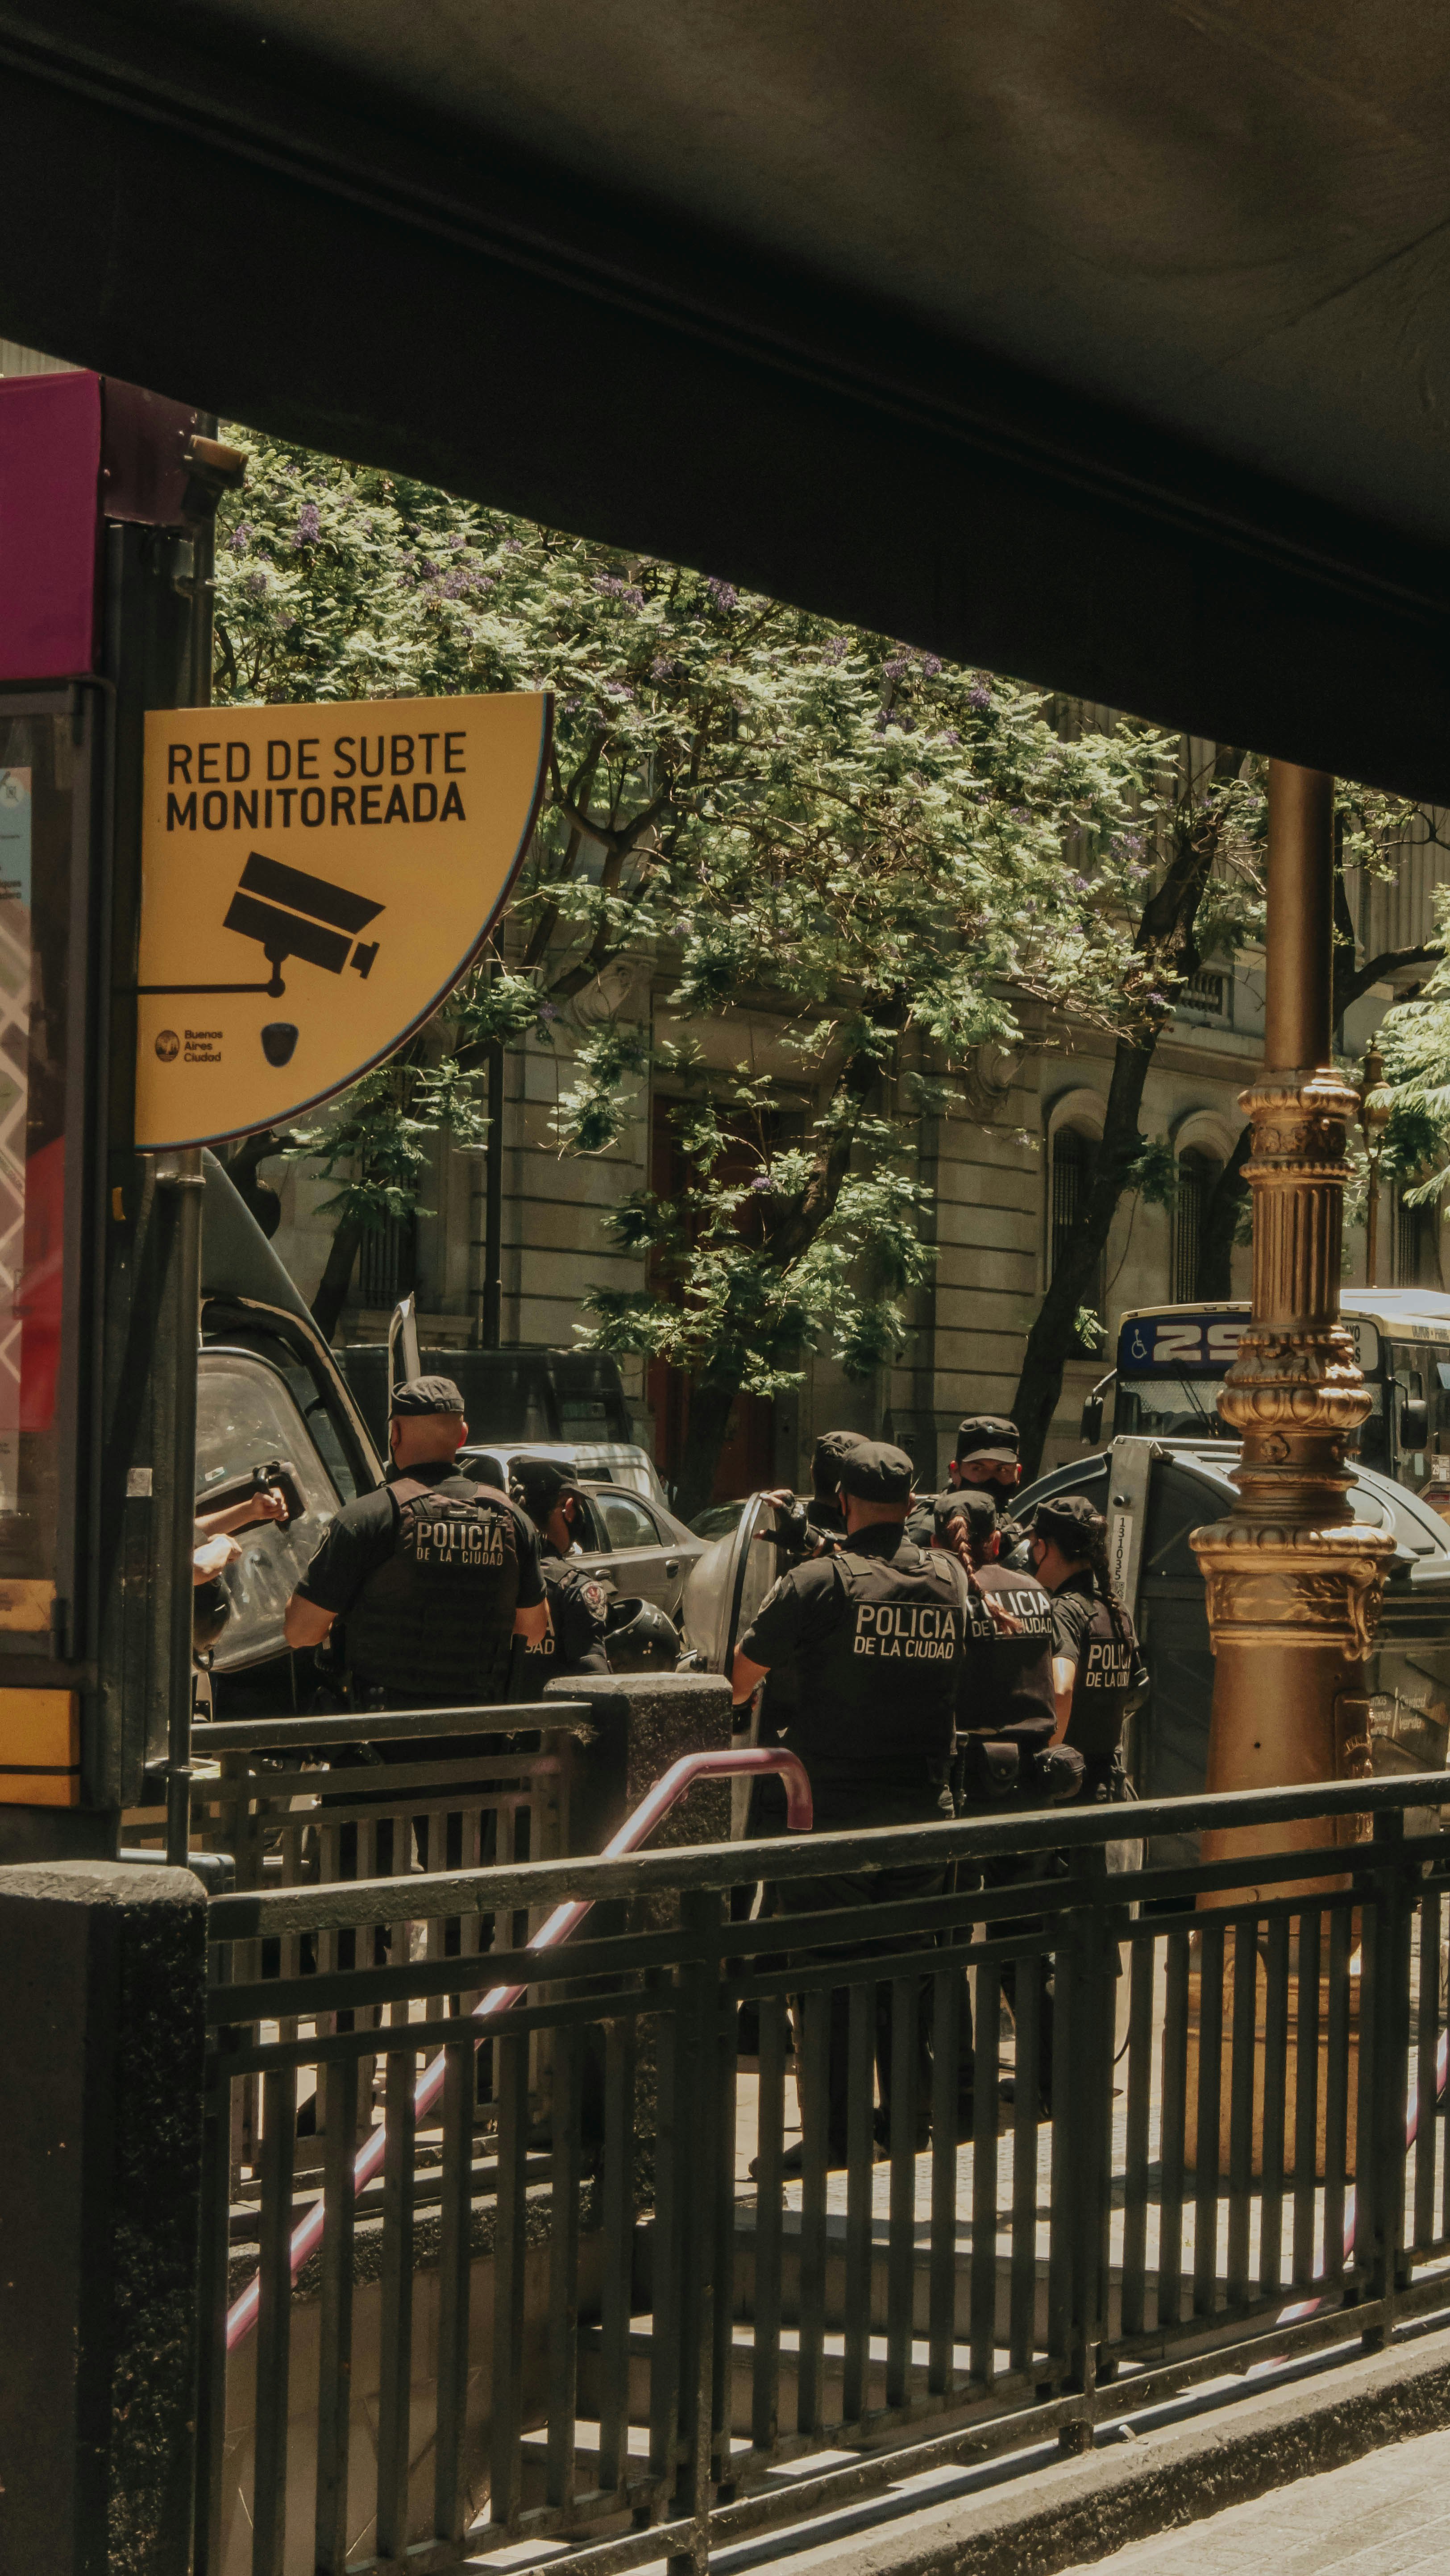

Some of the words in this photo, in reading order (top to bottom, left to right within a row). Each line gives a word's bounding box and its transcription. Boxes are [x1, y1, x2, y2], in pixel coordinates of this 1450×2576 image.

[168, 742, 250, 784] RED
[267, 739, 320, 781] DE
[334, 732, 466, 778] SUBTE
[167, 782, 466, 831] MONITOREADA
[185, 1030, 223, 1039] Buenos
[185, 1041, 212, 1050] Aires
[184, 1052, 221, 1062] Ciudad
[417, 1521, 503, 1552] POLICIA
[416, 1546, 430, 1560] DE
[440, 1548, 453, 1562] LA
[462, 1550, 503, 1566] CIUDAD
[1115, 1517, 1125, 1580] 131035
[856, 1605, 956, 1640] POLICIA
[972, 1620, 991, 1637] DE
[853, 1636, 877, 1655] DE
[881, 1638, 901, 1657] LA
[905, 1640, 954, 1659] CIUDAD
[1085, 1671, 1102, 1687] DE
[1105, 1672, 1116, 1687] LA
